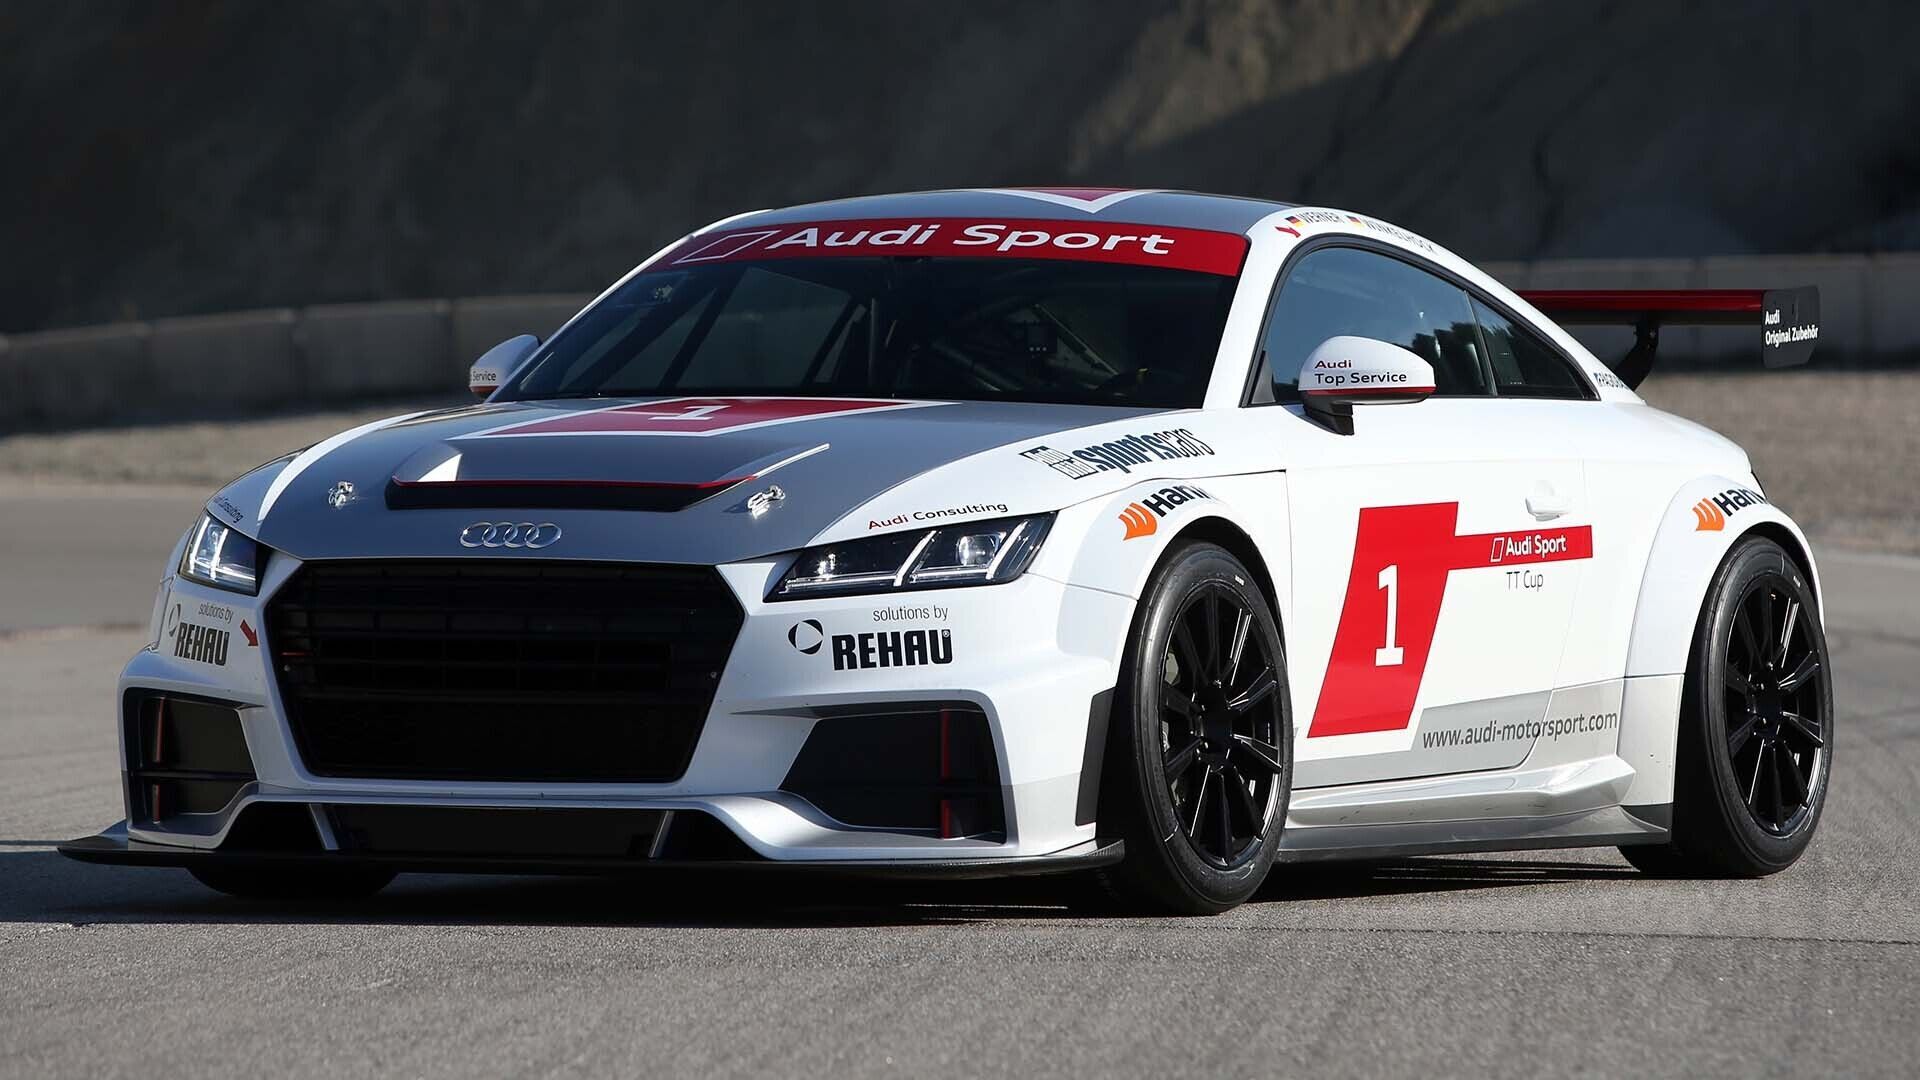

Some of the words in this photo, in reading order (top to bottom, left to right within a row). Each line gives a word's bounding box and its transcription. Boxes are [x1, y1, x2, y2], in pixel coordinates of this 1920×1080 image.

[765, 224, 940, 250] Audi
[953, 224, 1175, 255] Sport
[1765, 309, 1780, 326] Audi
[1765, 327, 1791, 348] Original
[1792, 324, 1819, 342] Zubehör
[472, 370, 497, 382] Service
[1314, 360, 1352, 369] Audi
[1314, 373, 1346, 386] Top
[1350, 372, 1408, 384] Service
[648, 405, 733, 421] 1
[1072, 428, 1216, 474] sportscars
[868, 514, 909, 530] Audi
[912, 503, 1009, 521] Consulting
[1505, 535, 1533, 556] Audi
[1534, 534, 1567, 559] Sport
[1506, 571, 1521, 590] TT
[1523, 570, 1544, 593] Cup
[199, 602, 225, 620] solutions
[225, 606, 235, 624] by
[872, 606, 930, 622] solutions
[933, 604, 949, 622] by
[1375, 564, 1404, 667] 1
[174, 621, 230, 667] REHAU
[831, 629, 953, 671] REHAU
[1422, 712, 1618, 749] www.audi-motorsport.com
